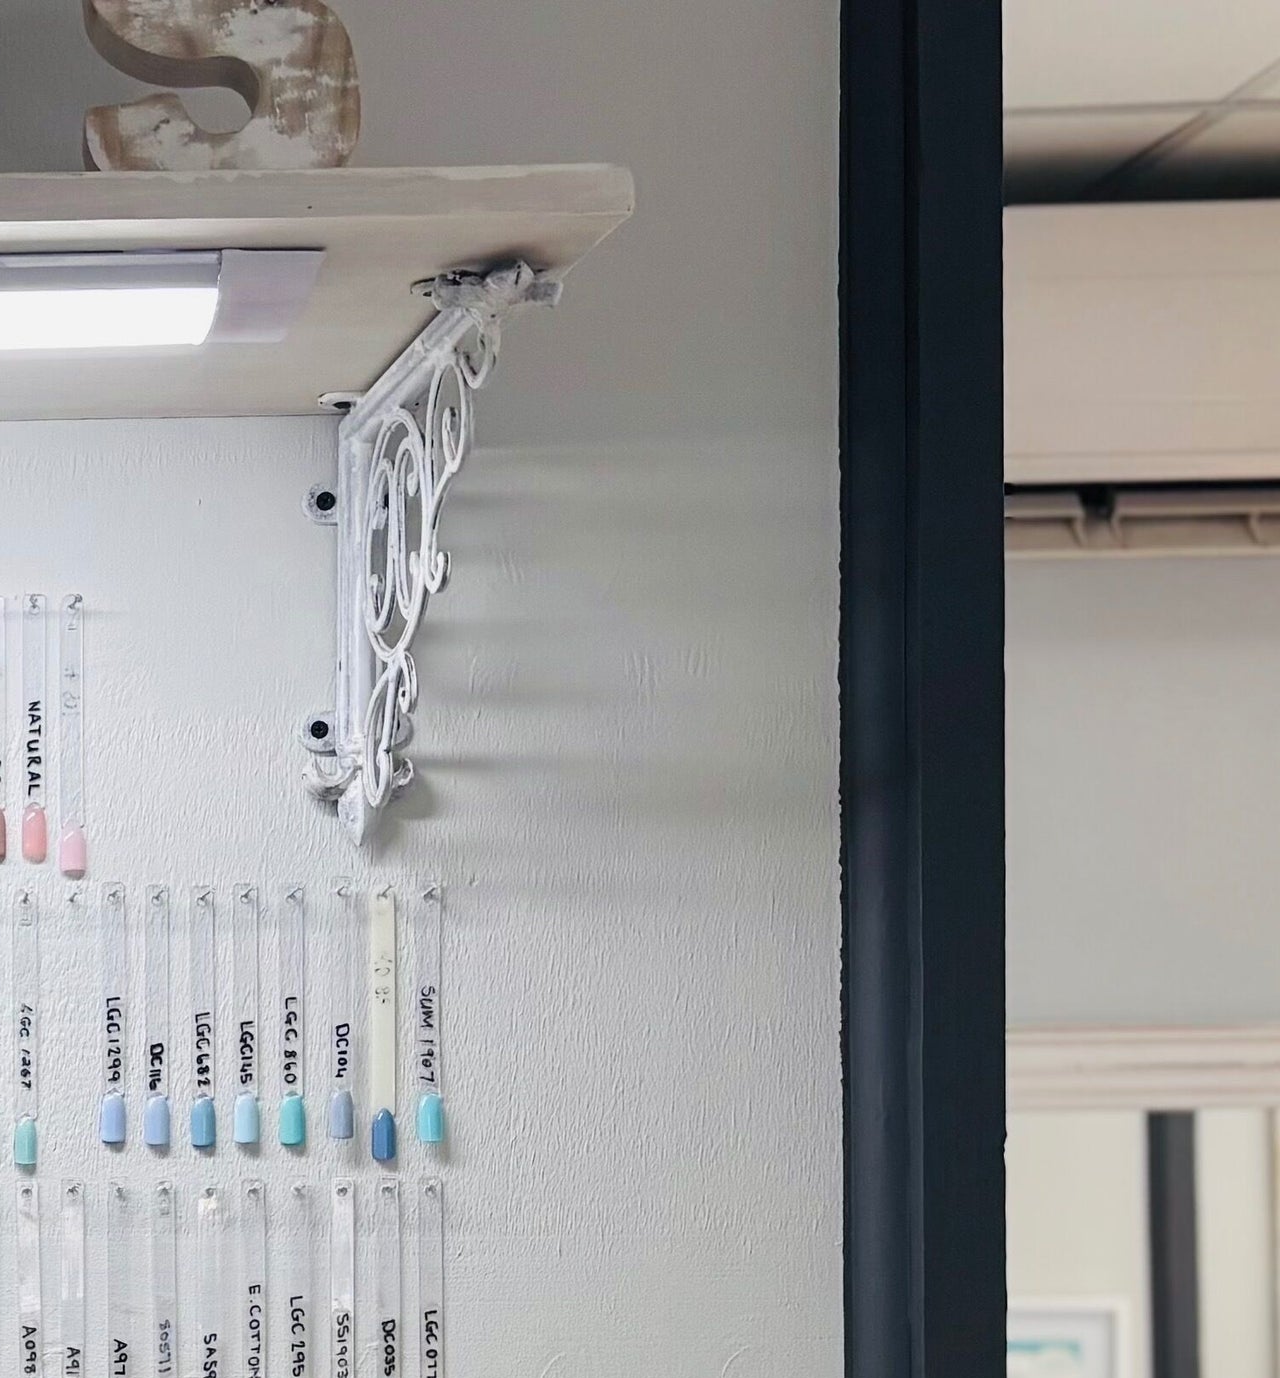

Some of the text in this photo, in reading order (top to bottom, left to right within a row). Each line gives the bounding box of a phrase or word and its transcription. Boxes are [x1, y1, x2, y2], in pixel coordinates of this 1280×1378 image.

[27, 700, 41, 796] NATURAL
[105, 996, 122, 1082] LGC1299
[195, 1011, 211, 1088] LGC682
[239, 1020, 254, 1085] LGC145
[335, 1023, 350, 1078] DC104
[22, 1325, 38, 1375] A098
[65, 1346, 82, 1376] A91
[112, 1338, 128, 1376] A97
[381, 1319, 397, 1378] DC035
